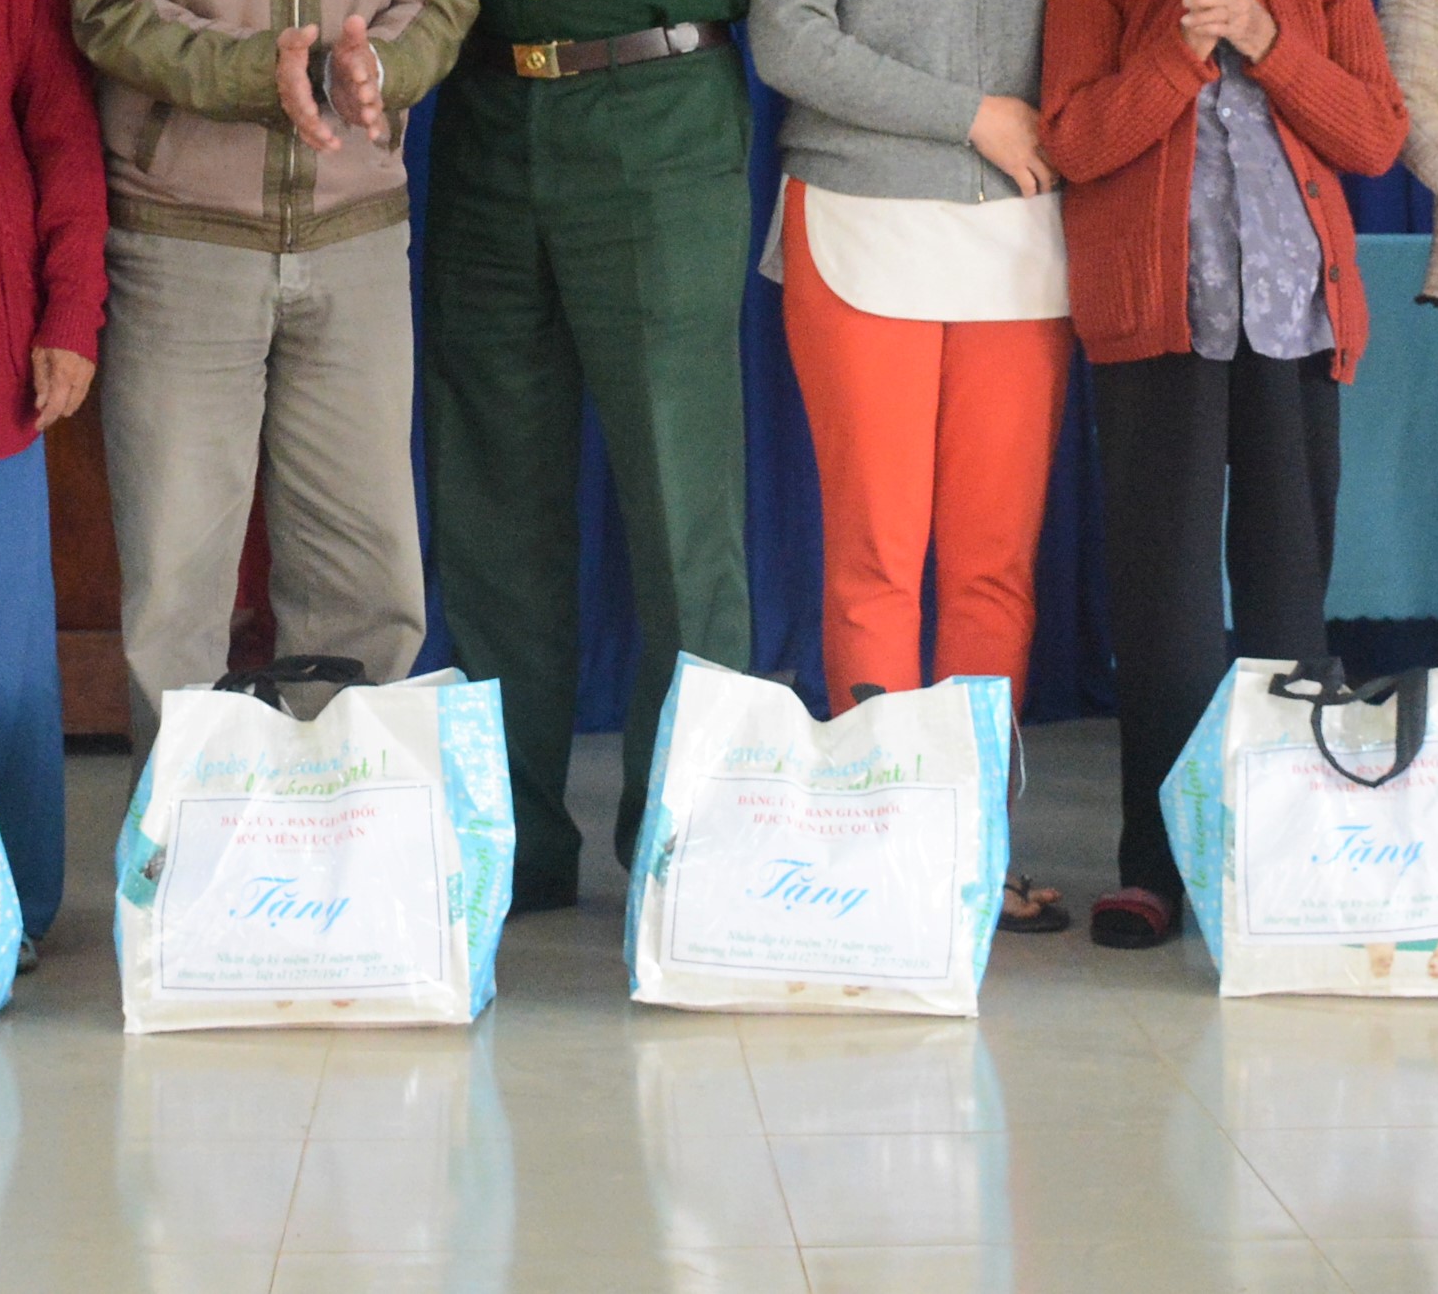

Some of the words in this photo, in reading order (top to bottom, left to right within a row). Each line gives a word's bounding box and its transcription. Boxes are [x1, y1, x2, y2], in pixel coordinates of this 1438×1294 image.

[1310, 823, 1426, 878] Tặng
[229, 875, 352, 935] Tặng
[745, 857, 871, 920] Tặng
